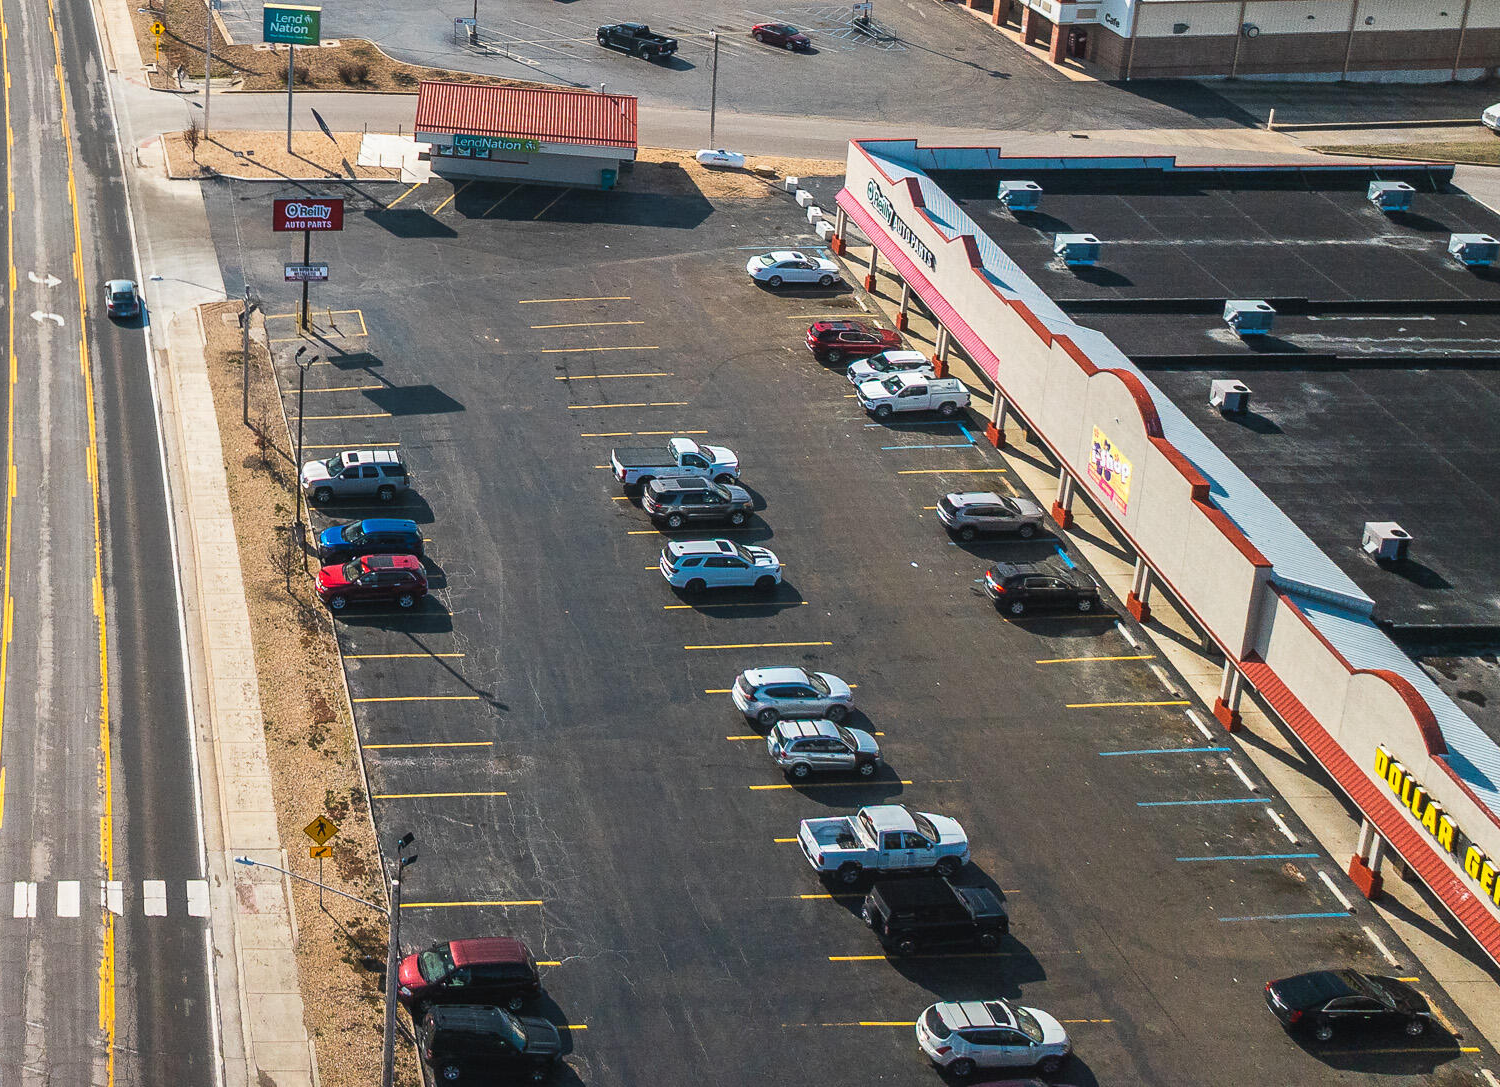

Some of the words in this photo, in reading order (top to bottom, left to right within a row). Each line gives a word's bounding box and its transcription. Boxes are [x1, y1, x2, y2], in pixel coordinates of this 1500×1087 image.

[275, 12, 303, 24] Lend
[1104, 12, 1120, 28] Cafe
[270, 22, 309, 34] Nation
[455, 136, 522, 150] LendNation
[285, 203, 331, 219] O'Reilly
[285, 220, 306, 229] AUTO
[307, 220, 332, 228] PARTS
[892, 214, 912, 244] AUTO
[910, 233, 934, 268] PARTS
[1374, 746, 1456, 853] DOLLAR
